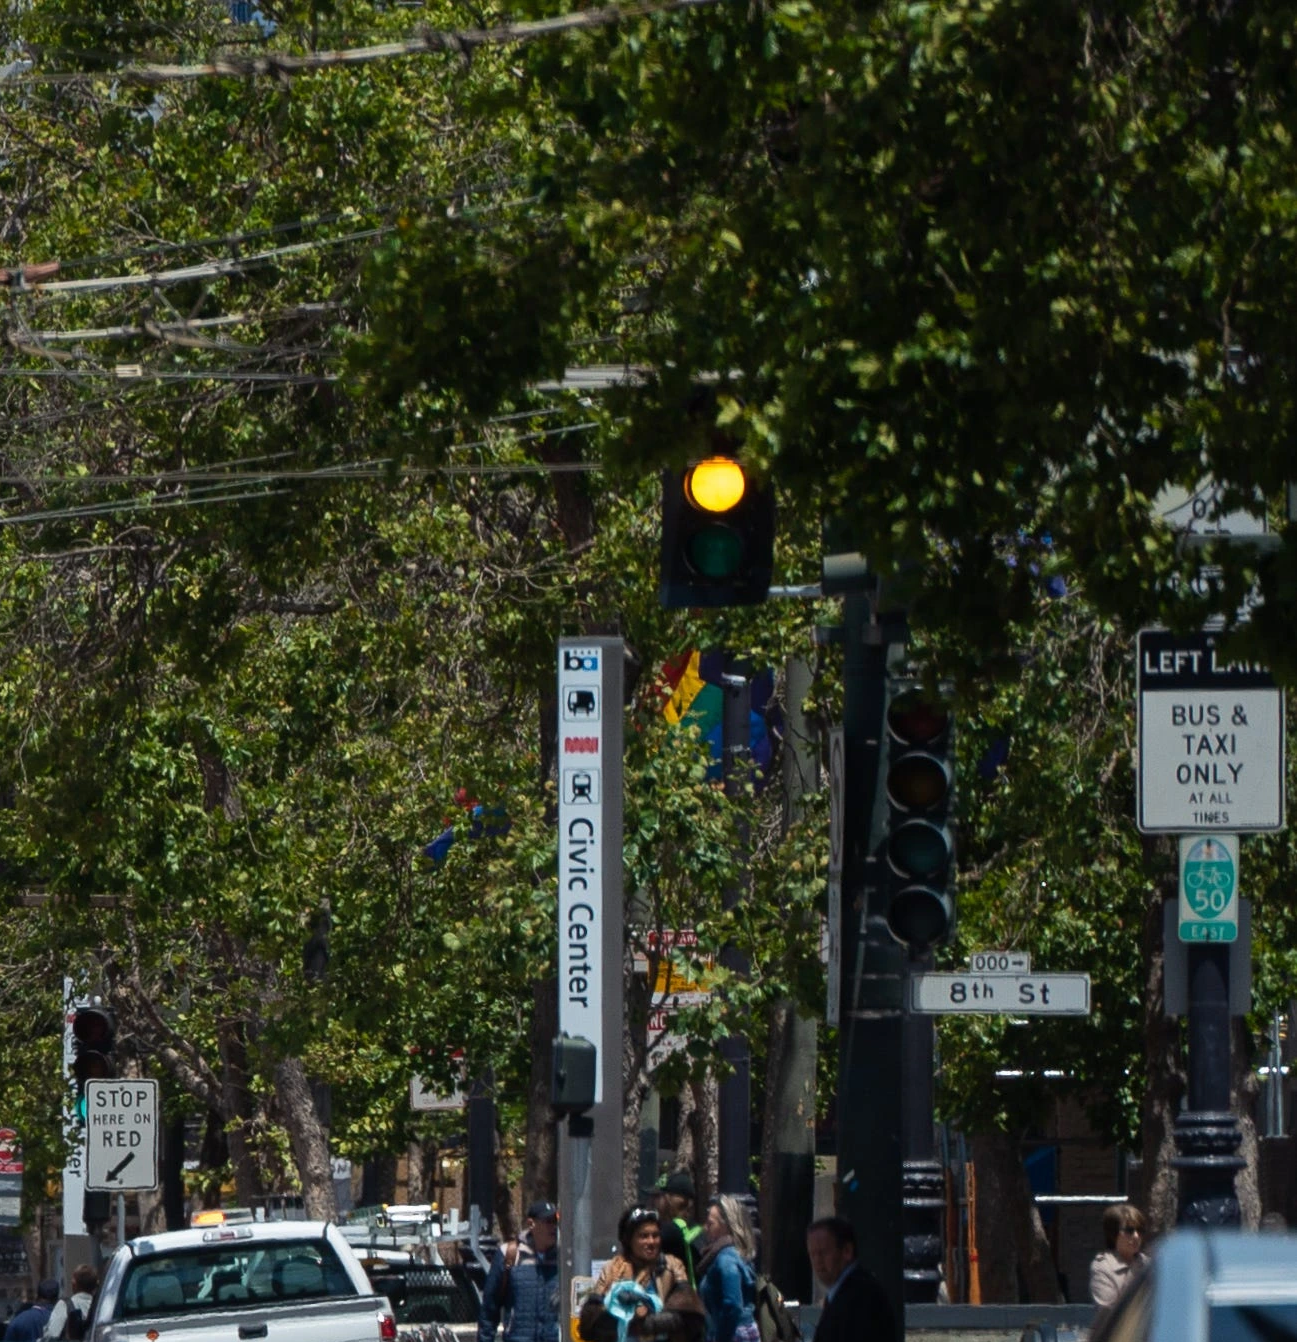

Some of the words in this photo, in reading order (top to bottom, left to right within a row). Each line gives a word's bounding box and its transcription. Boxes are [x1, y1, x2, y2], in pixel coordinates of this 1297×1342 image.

[1144, 651, 1202, 674] LEFT
[1211, 651, 1271, 674] LAN
[1172, 704, 1221, 727] BUS
[1231, 704, 1248, 727] &
[1183, 733, 1236, 756] TAXI
[1176, 764, 1244, 786] ONLY
[1189, 791, 1206, 805] AT
[1209, 791, 1233, 805] ALL
[568, 816, 595, 891] Civic
[1194, 889, 1226, 912] 50
[1191, 925, 1225, 940] EAST
[568, 902, 595, 1009] Center
[975, 955, 1009, 971] 000
[949, 982, 994, 1004] 8th
[1019, 982, 1050, 1005] St
[95, 1090, 148, 1108] STOP
[93, 1113, 125, 1125] HERE
[133, 1113, 151, 1124] ON
[102, 1130, 142, 1148] RED
